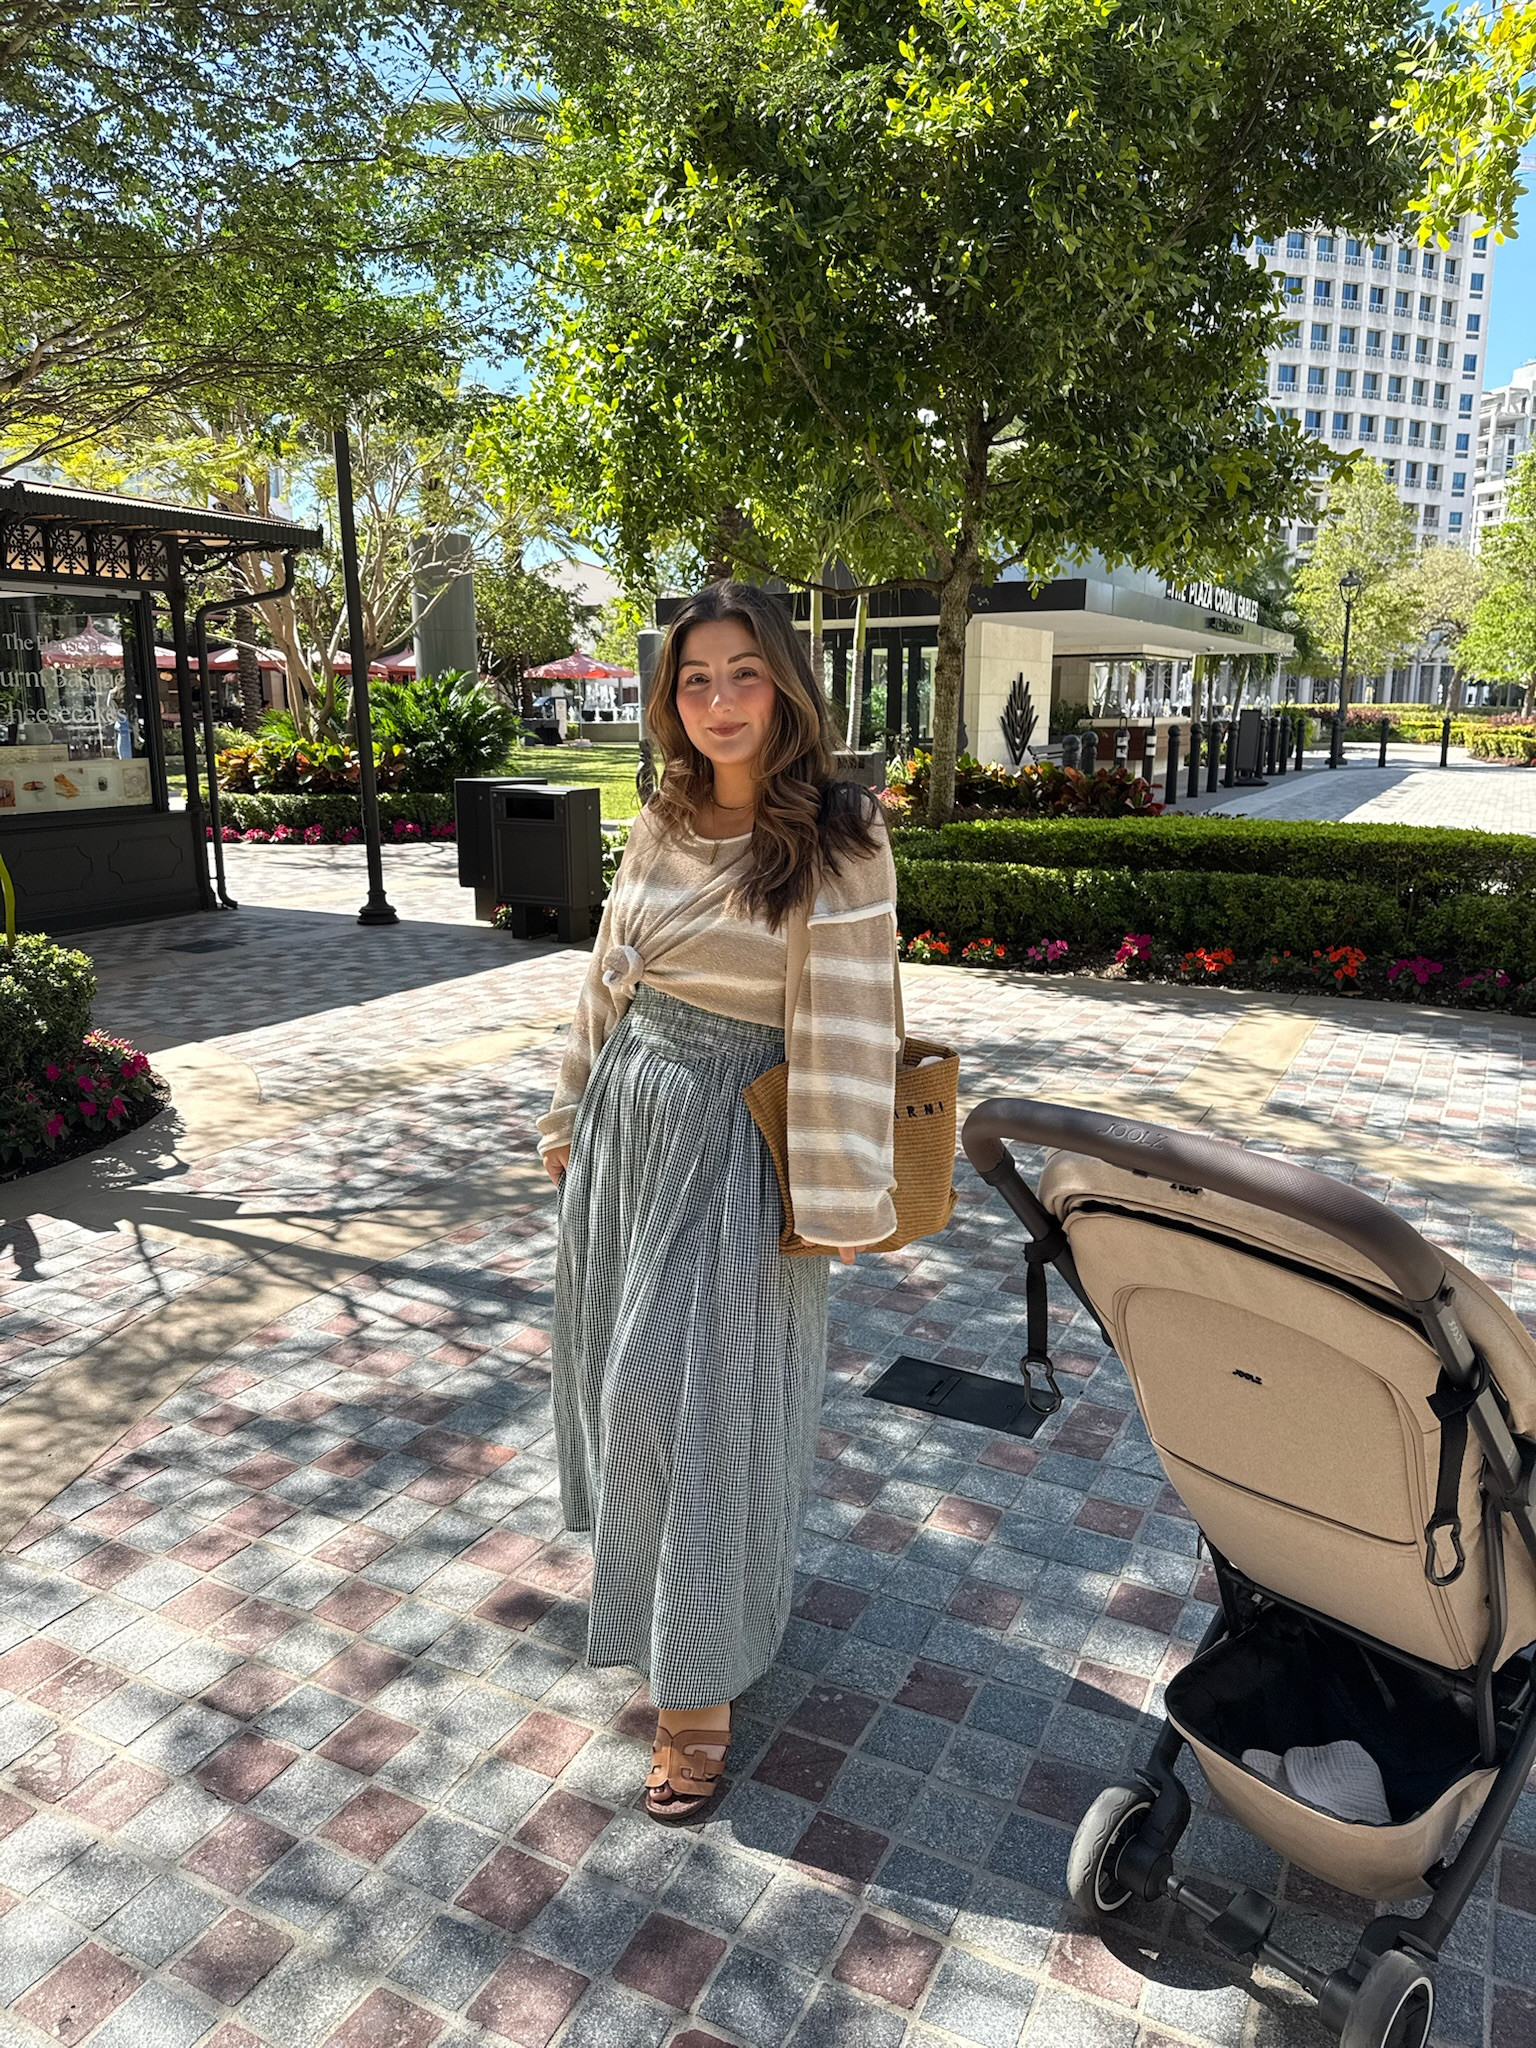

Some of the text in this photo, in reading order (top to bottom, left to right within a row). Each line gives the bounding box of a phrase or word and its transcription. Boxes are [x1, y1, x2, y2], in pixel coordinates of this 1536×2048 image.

[1189, 581, 1213, 609] PLAZA
[1214, 587, 1236, 617] CORAL
[1237, 595, 1259, 623] GABLES
[2, 632, 34, 651] The
[53, 668, 126, 694] Basque
[1097, 1122, 1168, 1149] JOOLZ
